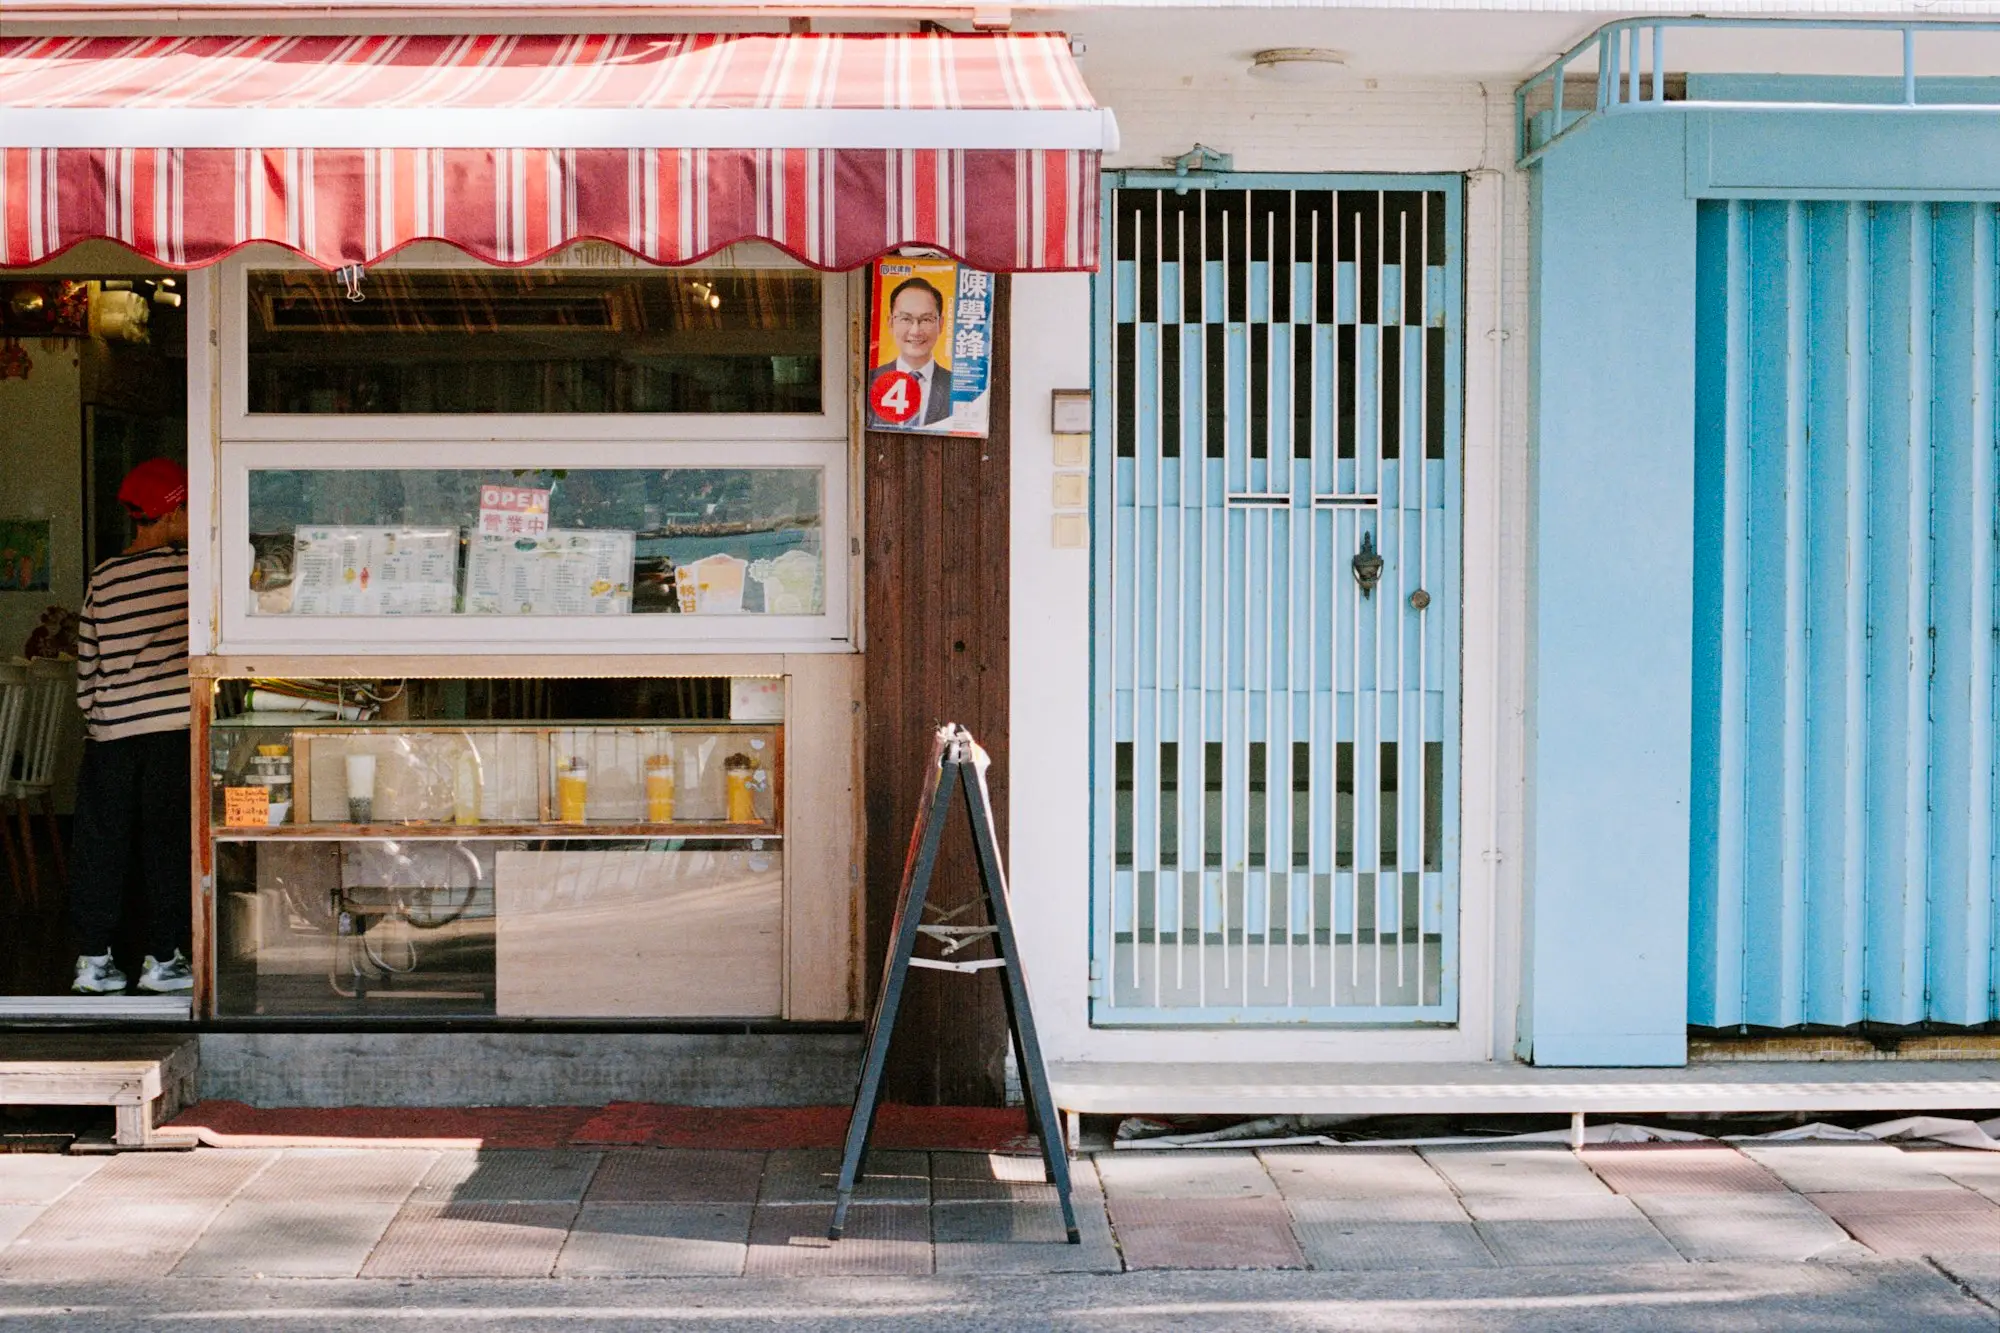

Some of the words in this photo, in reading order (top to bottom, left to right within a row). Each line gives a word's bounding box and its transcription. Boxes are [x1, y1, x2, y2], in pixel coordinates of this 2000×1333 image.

[955, 268, 987, 360] 陳學鋒
[881, 379, 910, 415] 4
[483, 490, 548, 508] OPEN
[483, 513, 545, 535] 營業中
